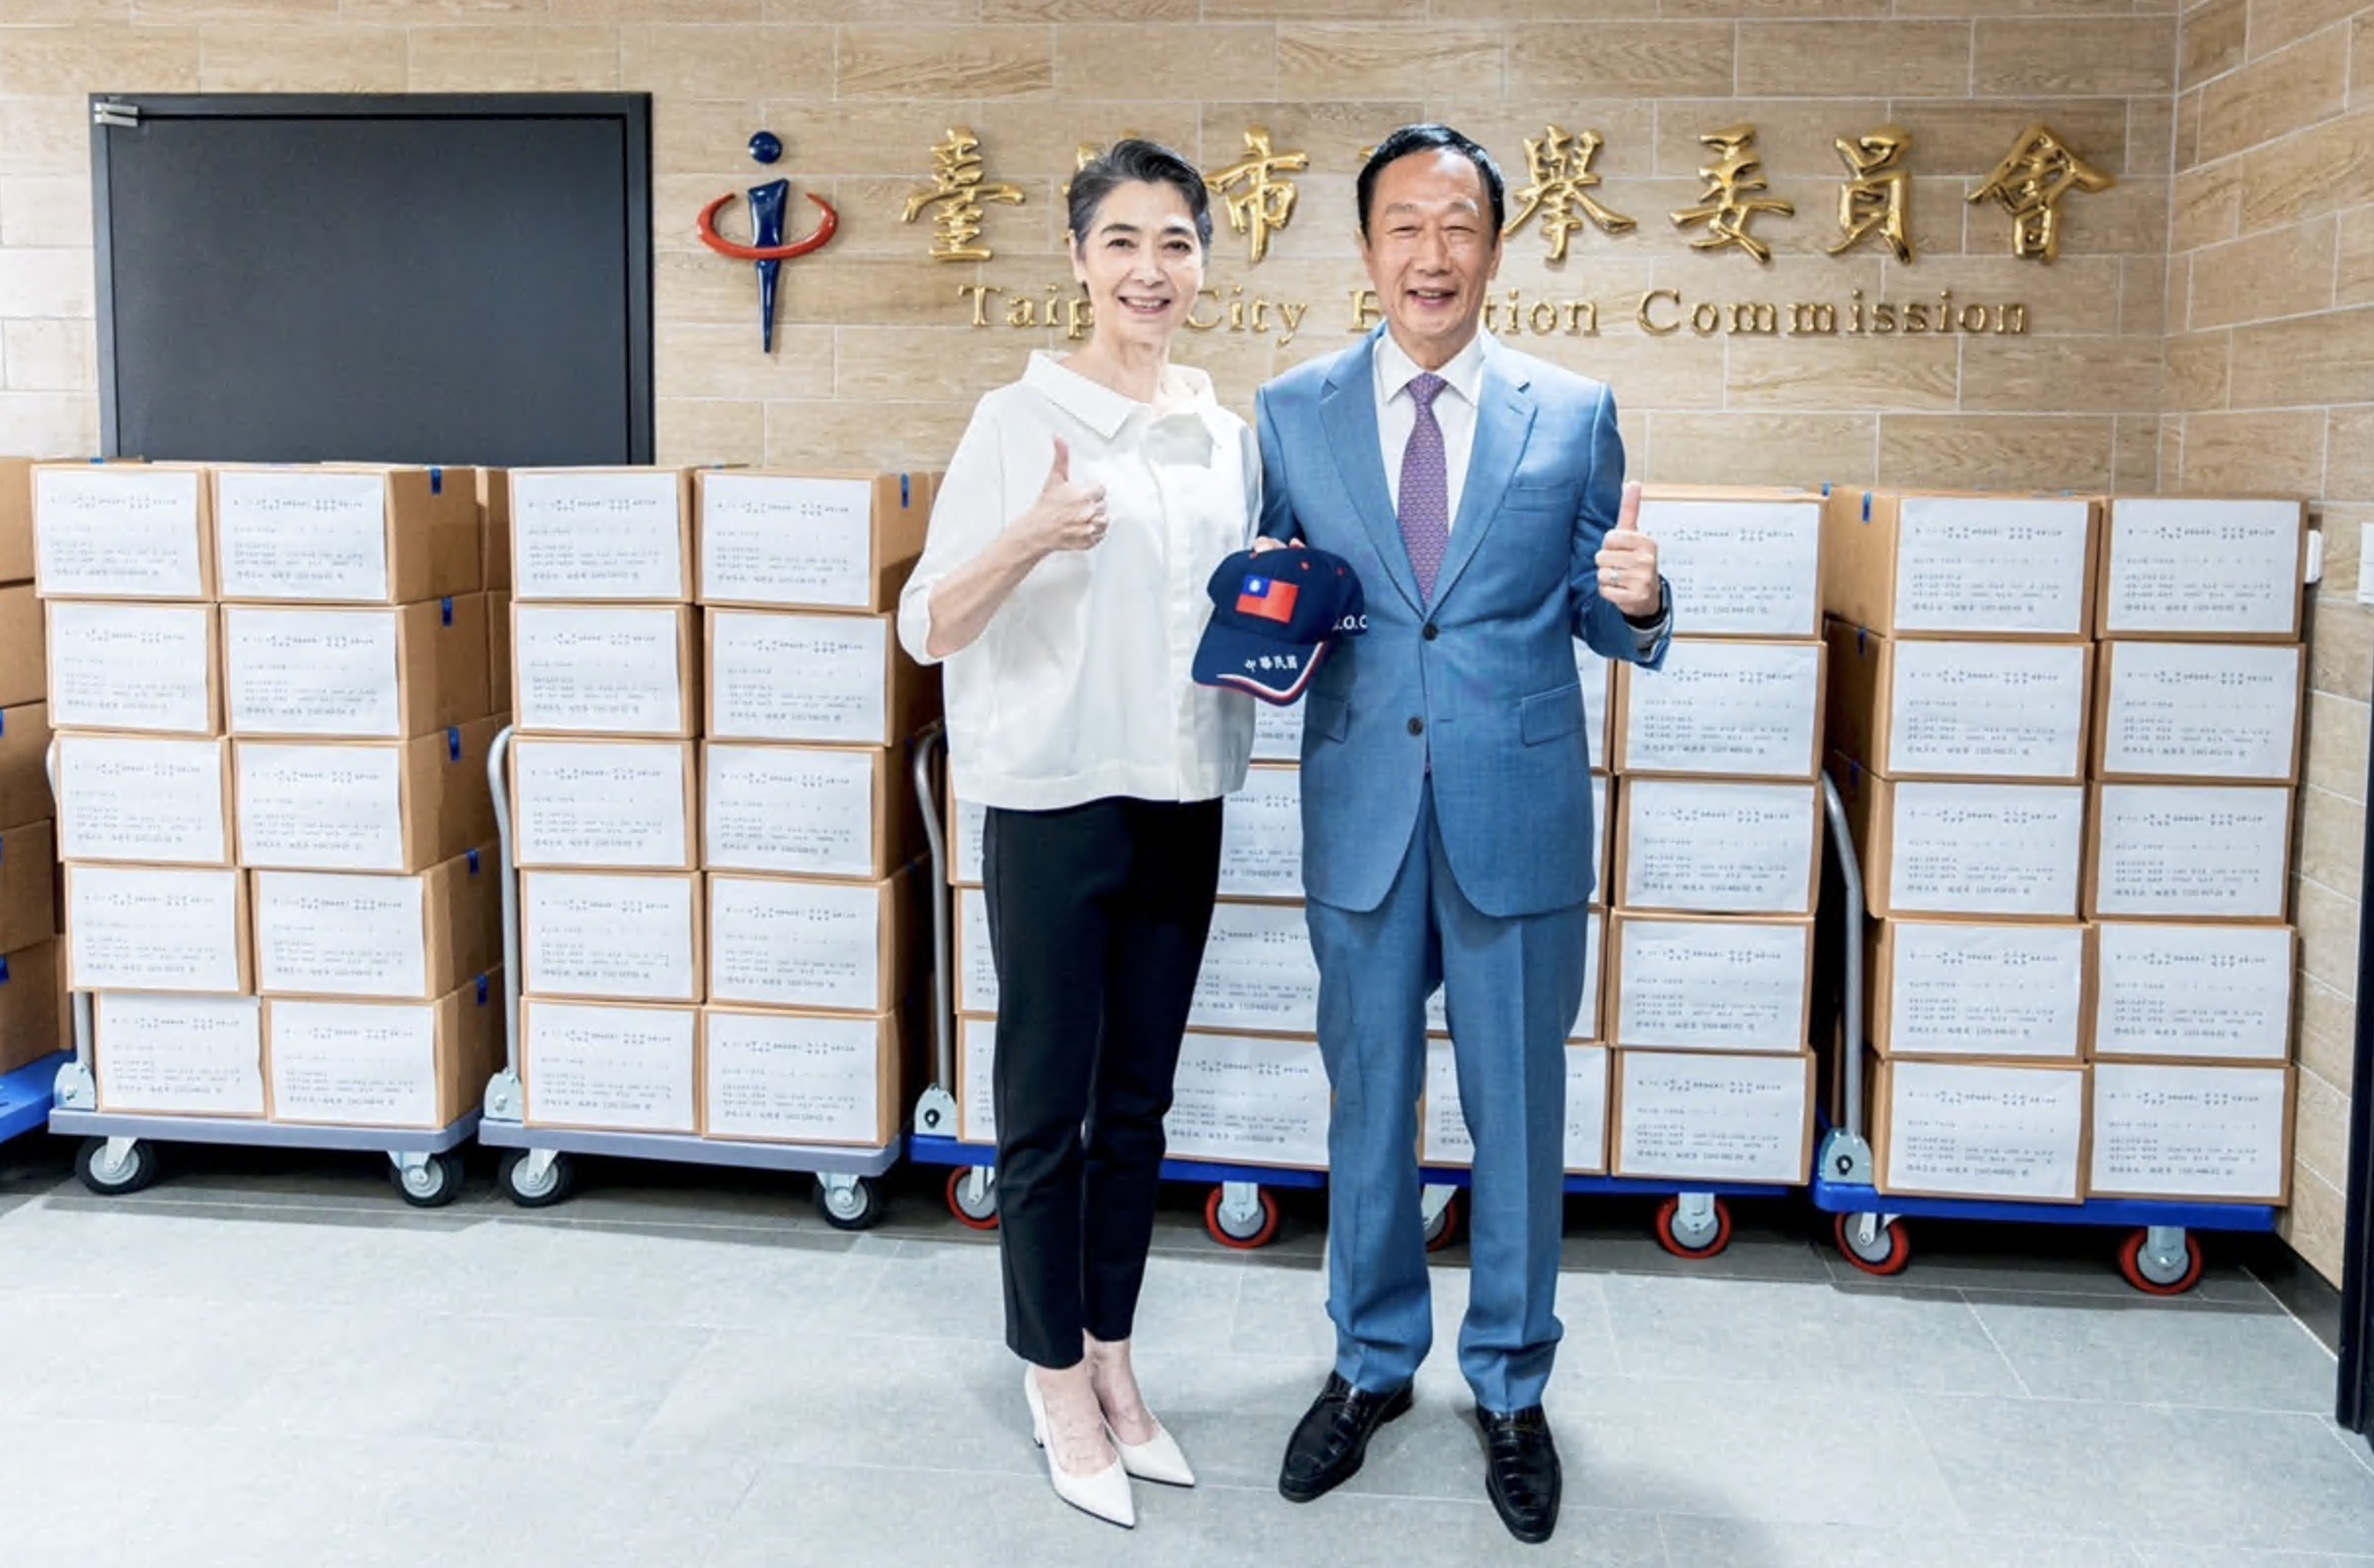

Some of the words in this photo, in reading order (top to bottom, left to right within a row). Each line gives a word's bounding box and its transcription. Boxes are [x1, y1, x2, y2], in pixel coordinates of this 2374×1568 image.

[900, 124, 2112, 265] 臺市舉委員會
[958, 284, 1095, 339] Taip
[1348, 289, 1601, 336] Etion
[1636, 288, 2028, 336] Commission
